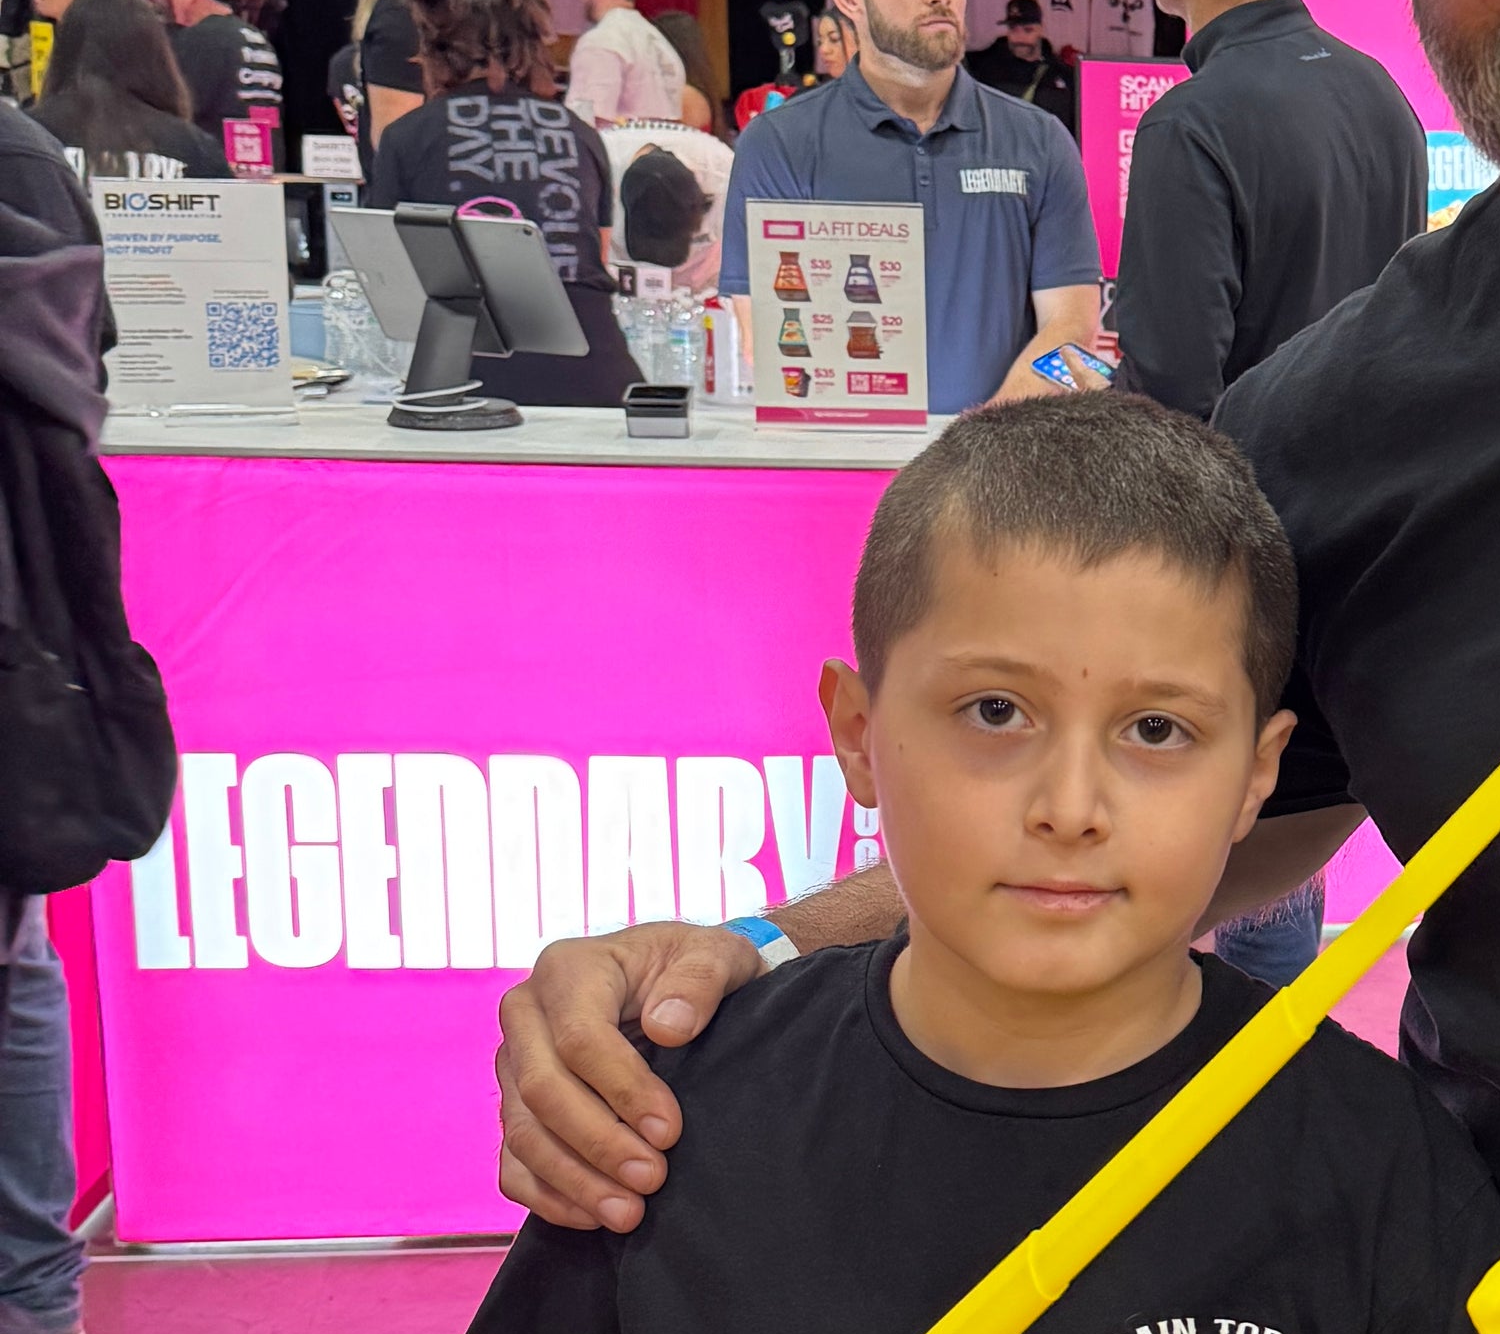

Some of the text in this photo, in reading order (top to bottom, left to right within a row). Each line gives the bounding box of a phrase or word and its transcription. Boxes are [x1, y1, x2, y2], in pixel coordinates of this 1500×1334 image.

[490, 97, 542, 184] THE
[104, 193, 221, 212] BIOSHIFT
[809, 222, 910, 238] LA FIT DEALS
[106, 233, 148, 243] DRIVEN
[150, 233, 165, 243] BY
[105, 245, 174, 255] NOT PROFIT
[810, 258, 833, 271] $35
[879, 260, 902, 272] $30
[812, 313, 834, 325] $25
[881, 315, 903, 327] $20
[132, 752, 849, 970] LEGENDARY
